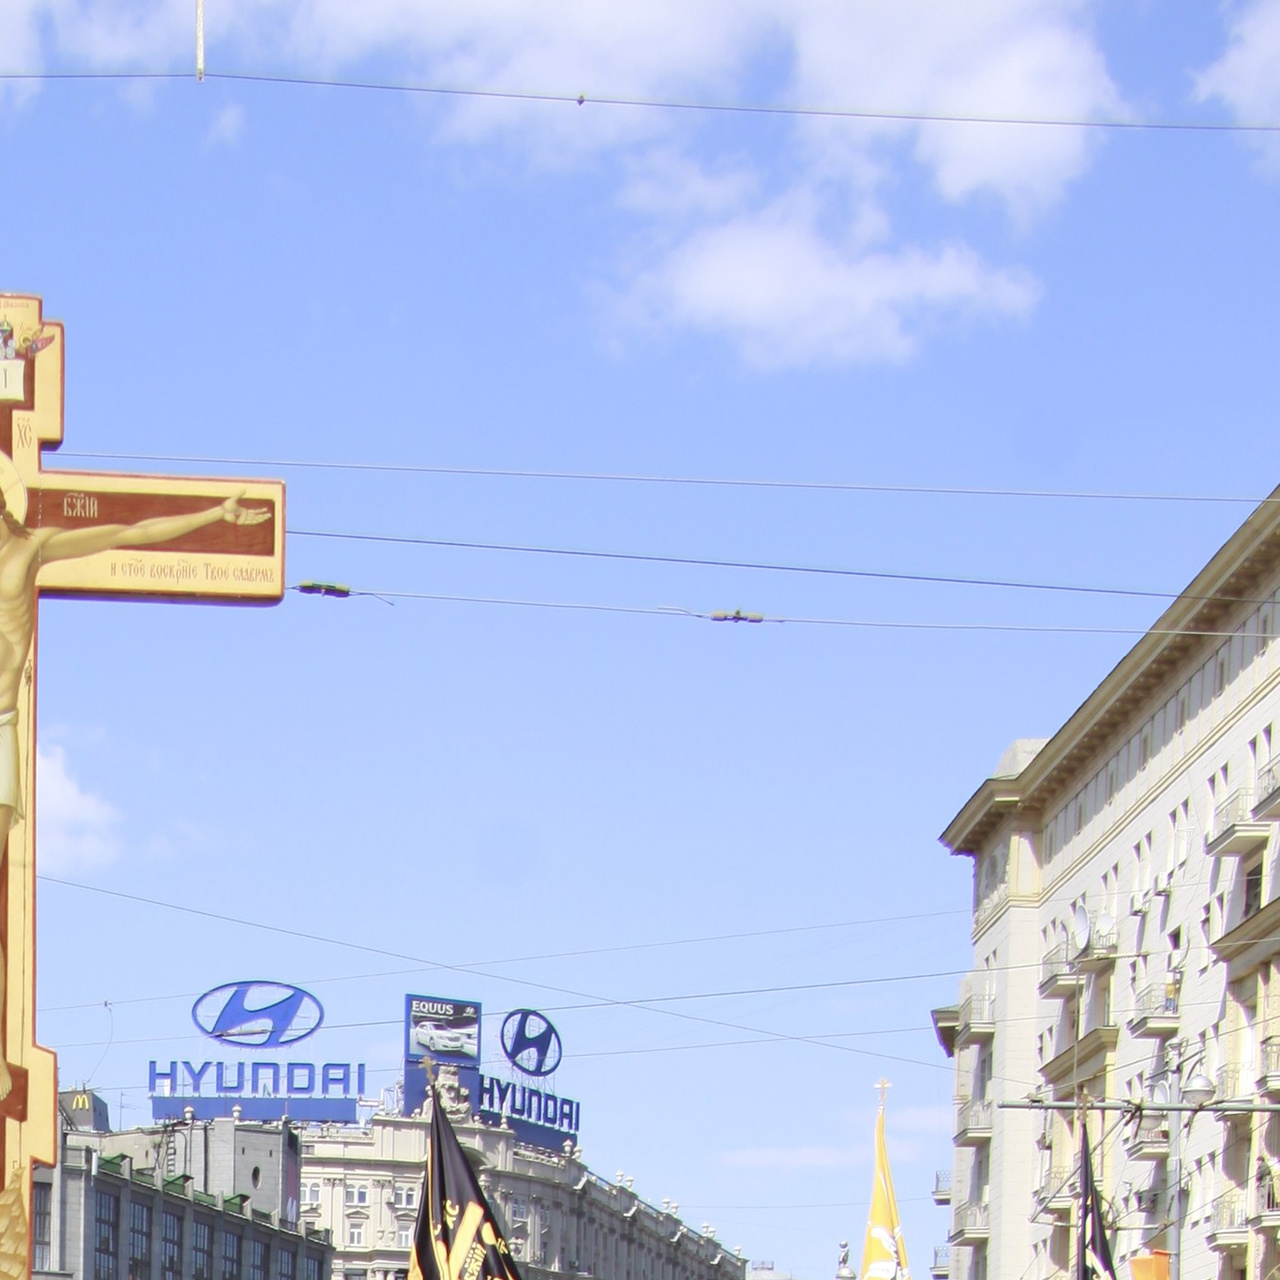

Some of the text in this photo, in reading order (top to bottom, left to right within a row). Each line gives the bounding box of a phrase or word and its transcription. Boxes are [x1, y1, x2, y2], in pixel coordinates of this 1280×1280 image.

[411, 1000, 454, 1015] EQUUS
[148, 1060, 366, 1096] HYUNDAI
[479, 1074, 580, 1132] HYUNDAI
